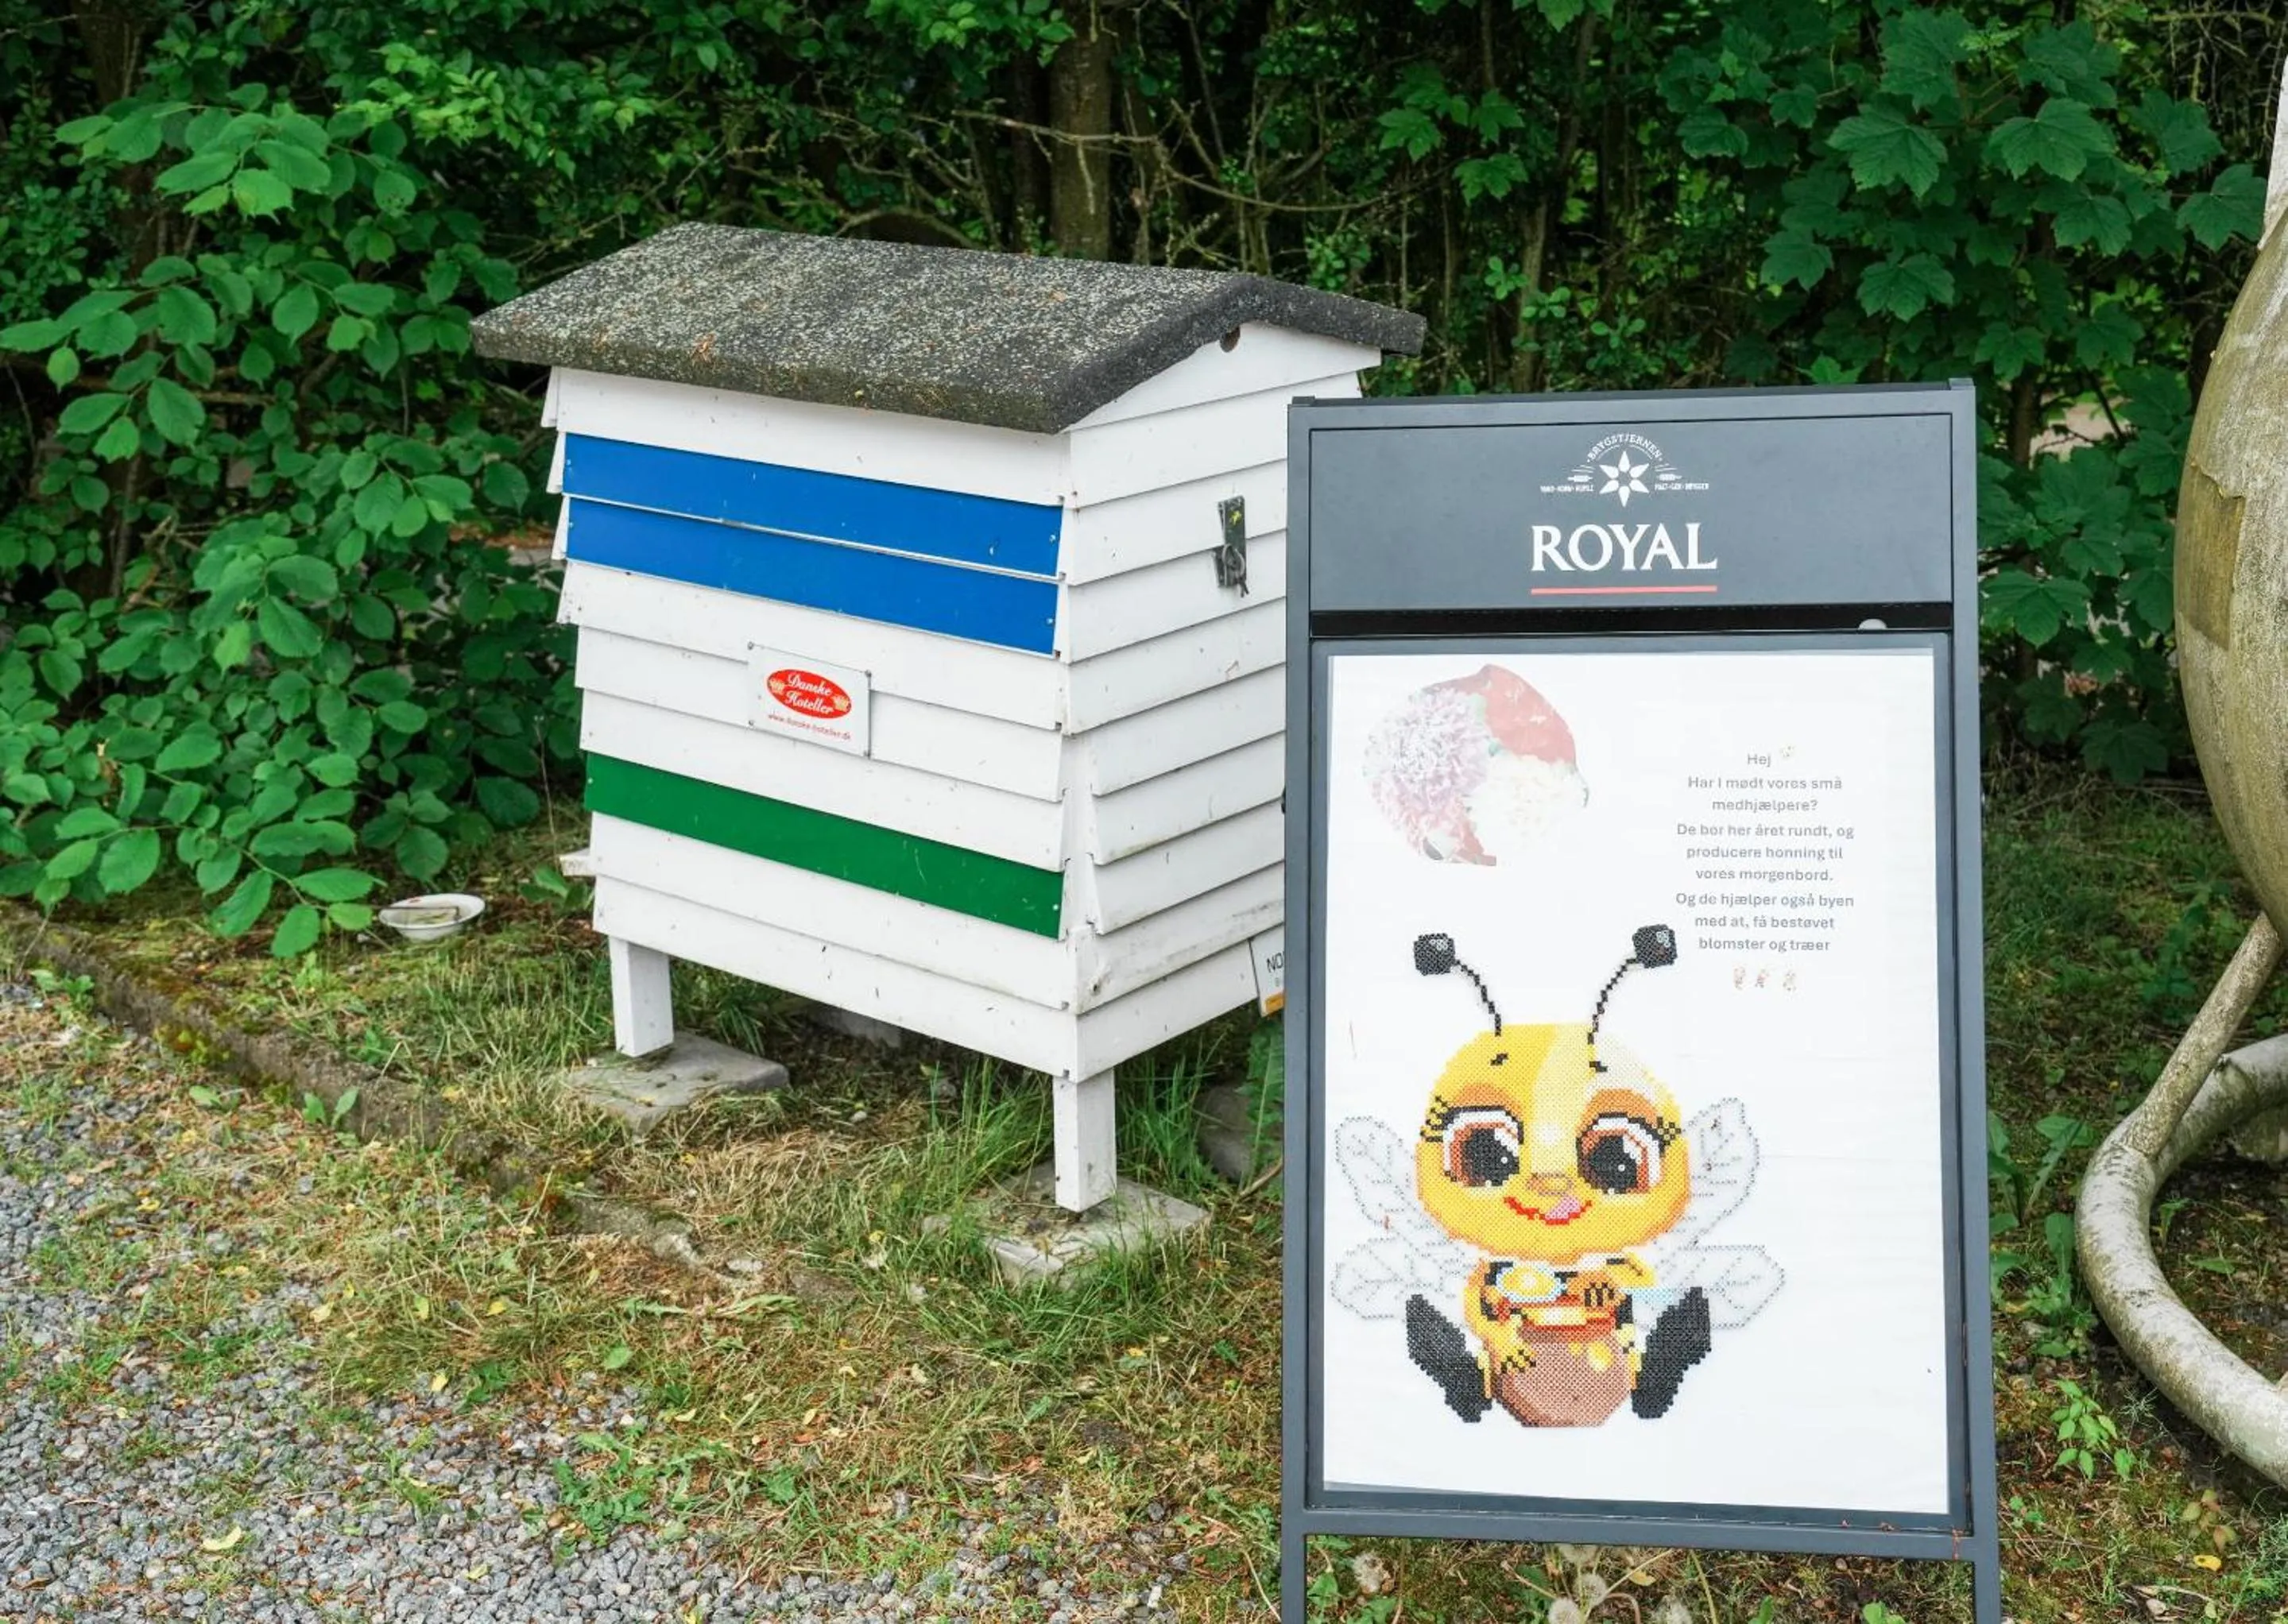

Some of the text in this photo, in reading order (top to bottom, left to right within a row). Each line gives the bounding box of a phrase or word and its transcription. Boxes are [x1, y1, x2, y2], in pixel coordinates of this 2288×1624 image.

[1531, 523, 1718, 572] ROYAL
[788, 673, 832, 696] Danske
[785, 690, 834, 715] Hoteller
[1747, 753, 1771, 767] Hej
[1687, 775, 1715, 789] Har
[1725, 776, 1763, 789] mødt
[1767, 779, 1807, 790] vores
[1811, 776, 1843, 790] små
[1712, 798, 1819, 814] medhjælpere?
[1677, 822, 1855, 840] De bor her året rundt, og
[1686, 845, 1844, 862] producere honning til
[1695, 868, 1833, 884] vores morgenbord.
[1675, 892, 1854, 910] Og de hjælper også byen
[1694, 914, 1835, 930] med at, få bestøvet
[1698, 937, 1831, 953] blomster og træer
